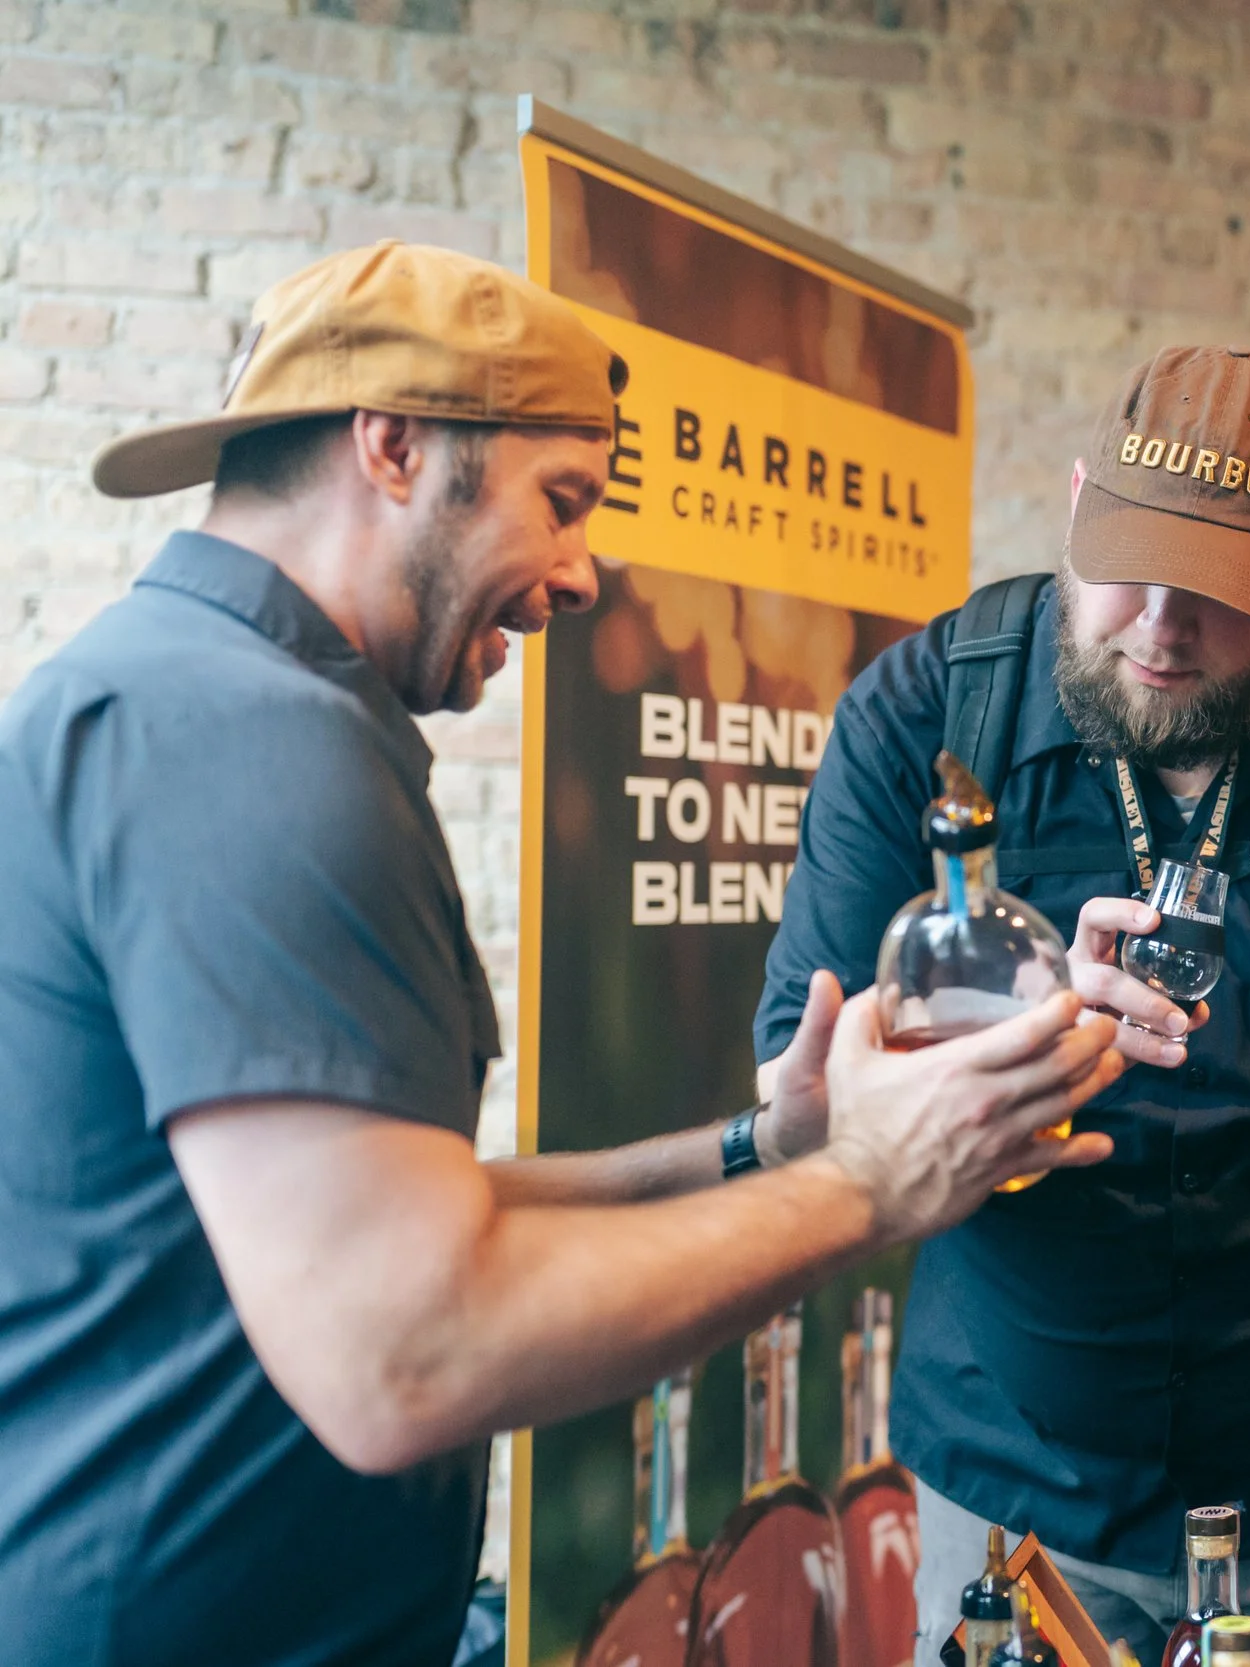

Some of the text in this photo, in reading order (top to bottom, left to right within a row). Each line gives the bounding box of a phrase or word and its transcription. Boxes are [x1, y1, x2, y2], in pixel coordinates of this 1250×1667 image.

[674, 407, 927, 527] BARRELL
[672, 486, 927, 578] CRAFT SPIRITS
[641, 692, 835, 770] BLEND
[624, 776, 812, 845] TO NE
[632, 861, 796, 926] BLEN
